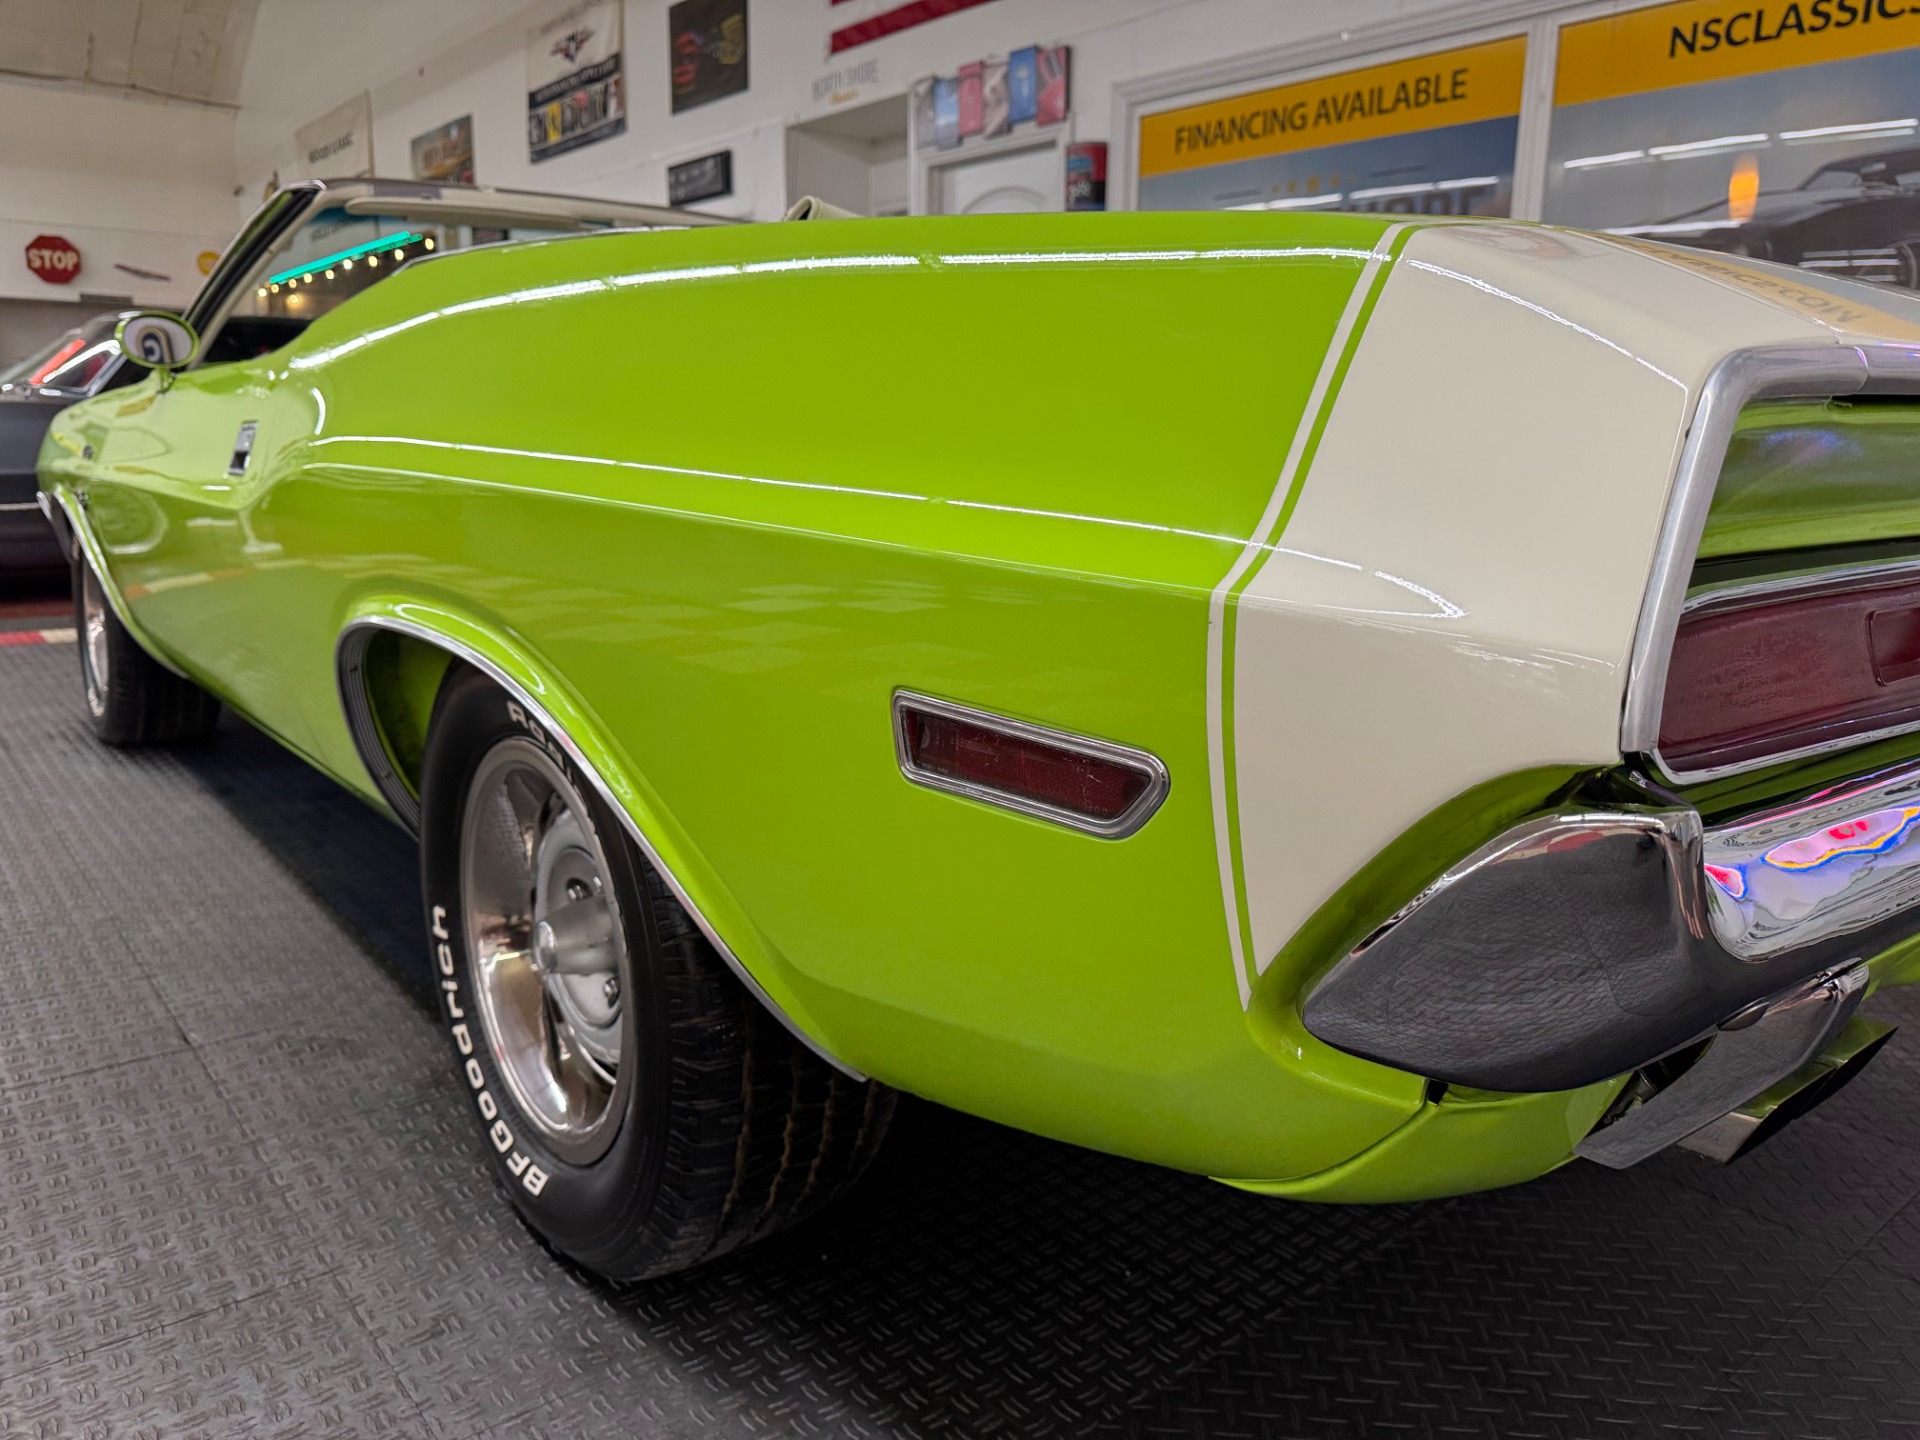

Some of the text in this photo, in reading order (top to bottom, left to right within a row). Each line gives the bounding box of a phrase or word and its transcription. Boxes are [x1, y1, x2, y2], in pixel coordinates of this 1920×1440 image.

[1175, 67, 1468, 155] FINANCING AVAILABLE
[28, 248, 78, 271] STOP
[432, 905, 549, 1196] BFGoodrich
